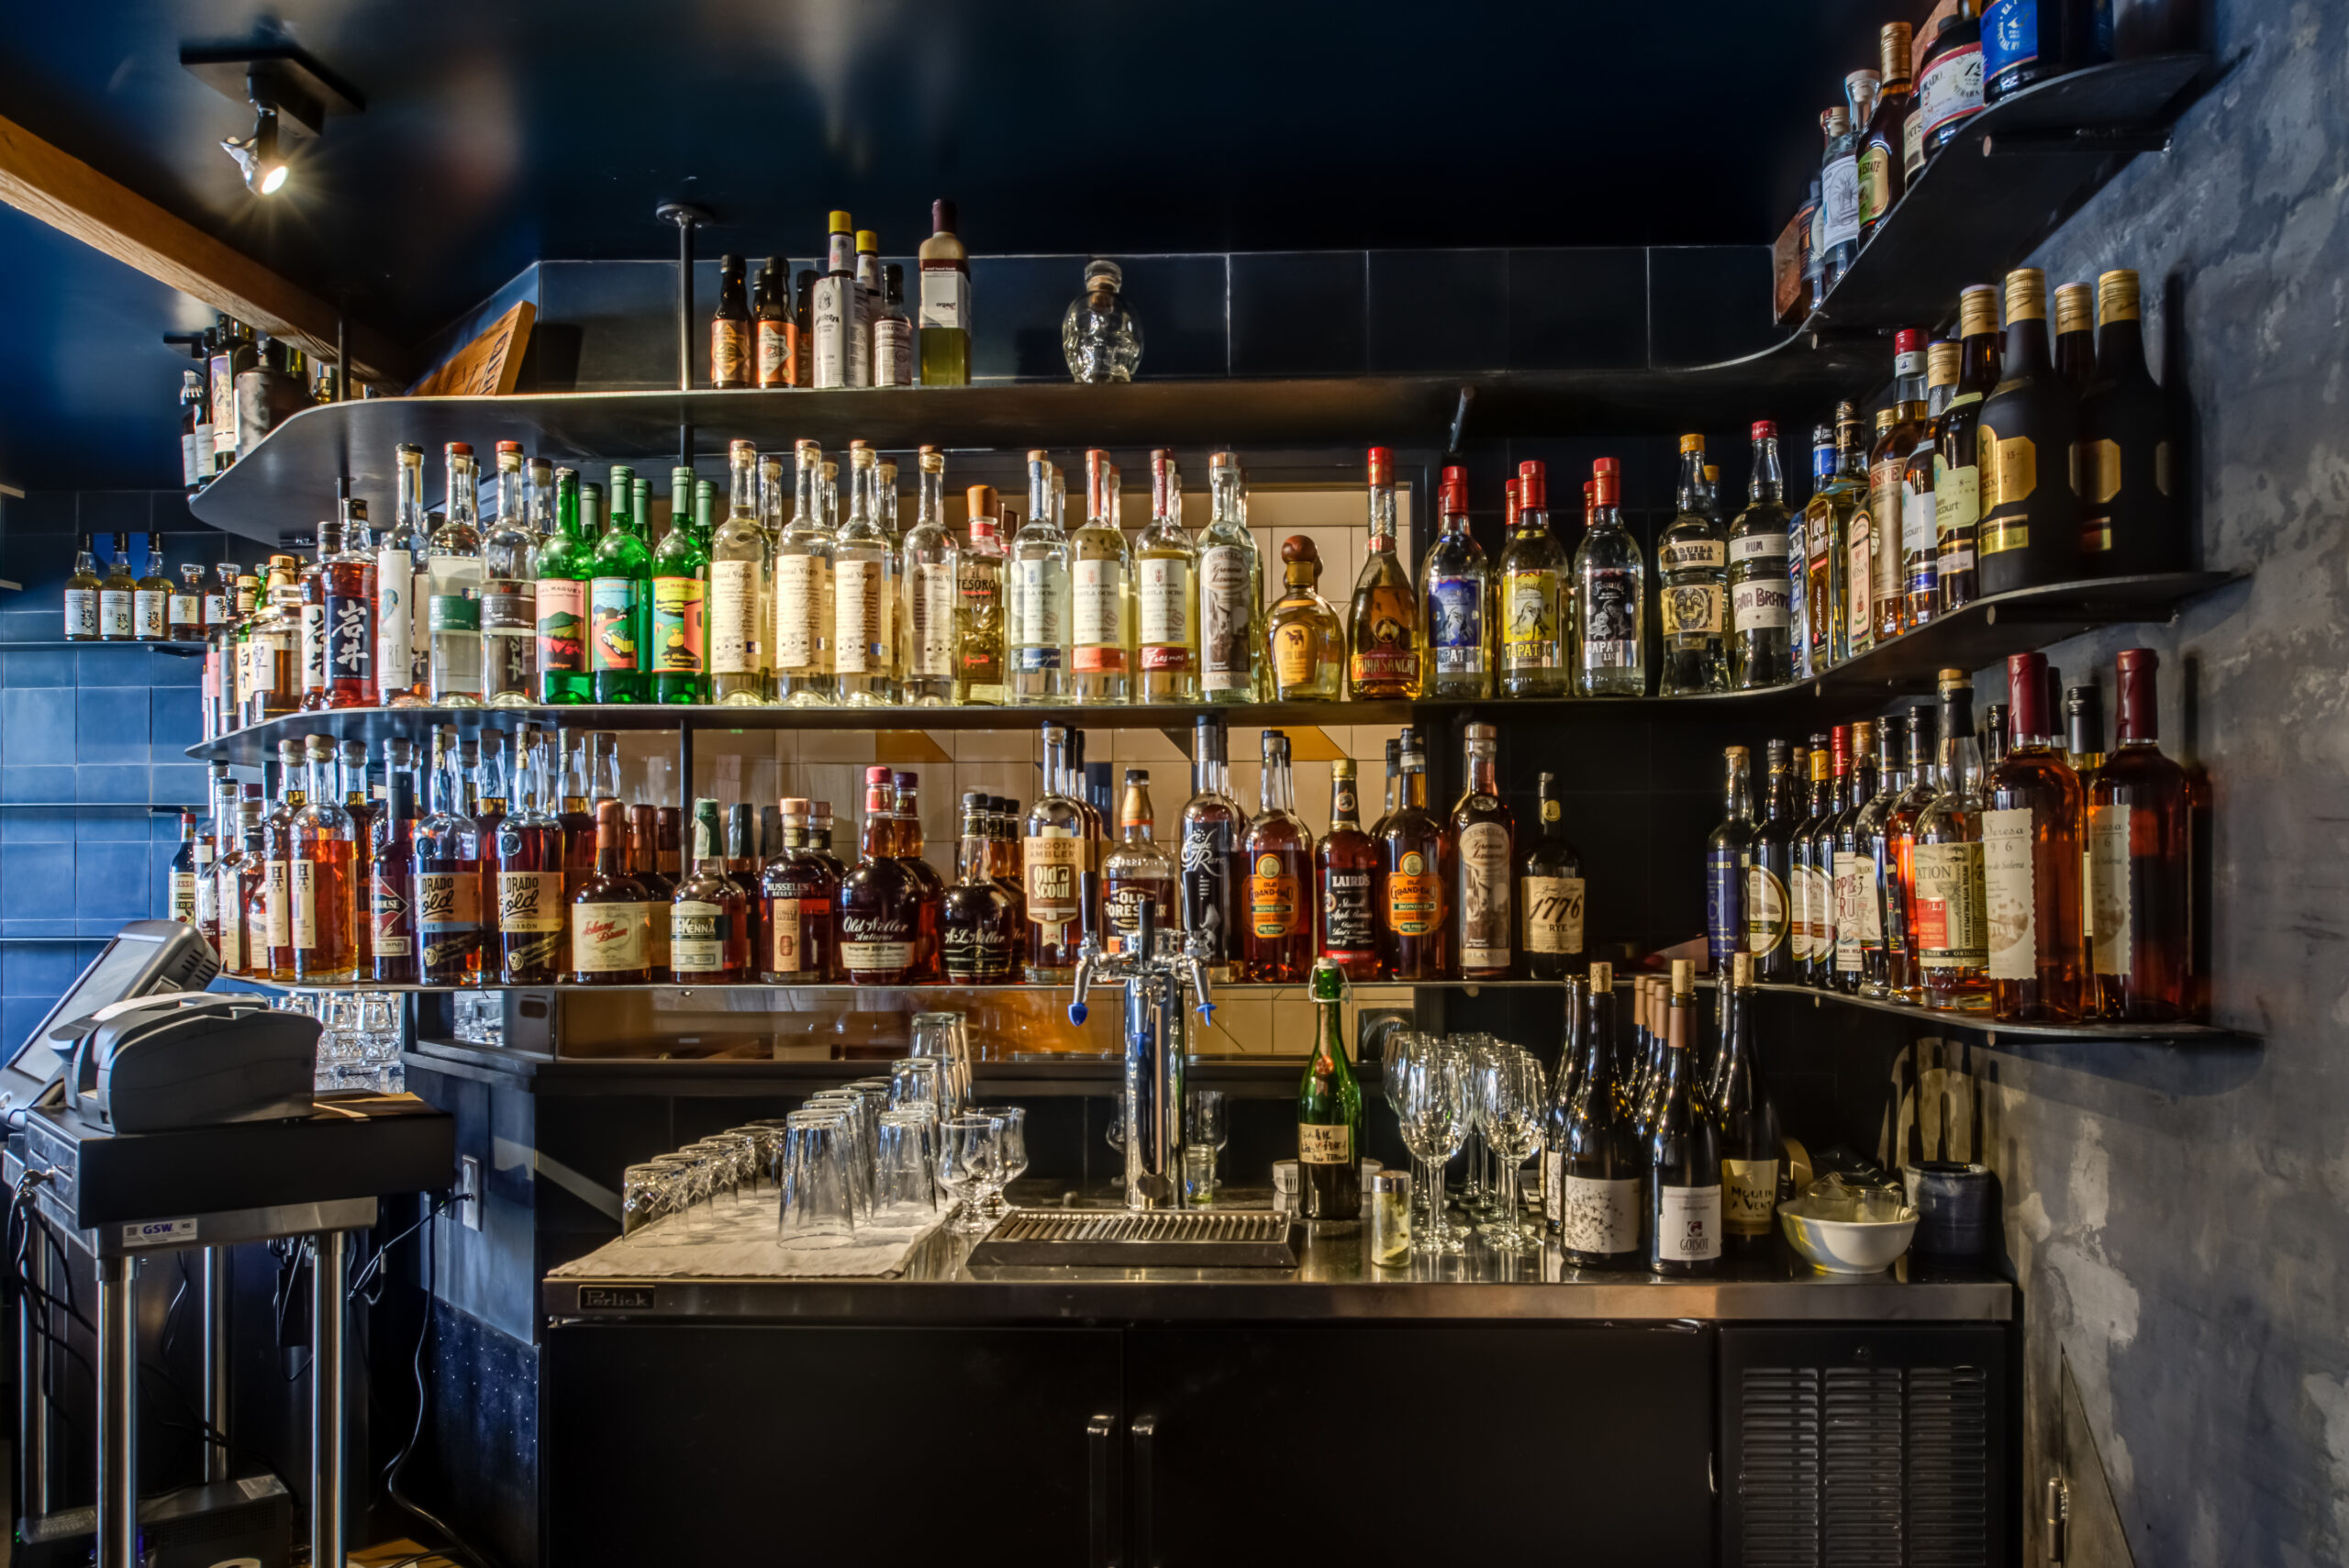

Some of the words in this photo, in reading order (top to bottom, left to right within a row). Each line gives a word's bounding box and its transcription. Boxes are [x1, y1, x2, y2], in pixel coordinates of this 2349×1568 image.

[1863, 161, 1881, 172] ESTATE
[1745, 540, 1764, 553] RUM
[551, 585, 582, 595] MAGUEY
[670, 583, 700, 591] MAGUEY
[956, 579, 996, 591] TESORO
[331, 600, 369, 672] 岩井
[1986, 820, 2024, 837] Teresa
[1029, 850, 1075, 859] AMBLER
[1181, 832, 1211, 869] Eagle
[2002, 860, 2025, 870] Solera
[1033, 865, 1058, 884] Old
[1331, 873, 1371, 887] LAIRD'S
[1033, 882, 1070, 899] Scout
[1119, 892, 1146, 905] OLD
[1528, 894, 1583, 923] 1776
[1840, 897, 1857, 918] RU
[582, 920, 616, 939] Johnny
[842, 916, 864, 933] Old
[865, 916, 909, 933] Weller
[1549, 924, 1568, 932] RYE
[969, 928, 1006, 945] Weller
[1743, 1198, 1772, 1211] VENT
[142, 1223, 173, 1235] GSW
[1679, 1238, 1709, 1251] GOISOT
[584, 1290, 649, 1307] Perlick
